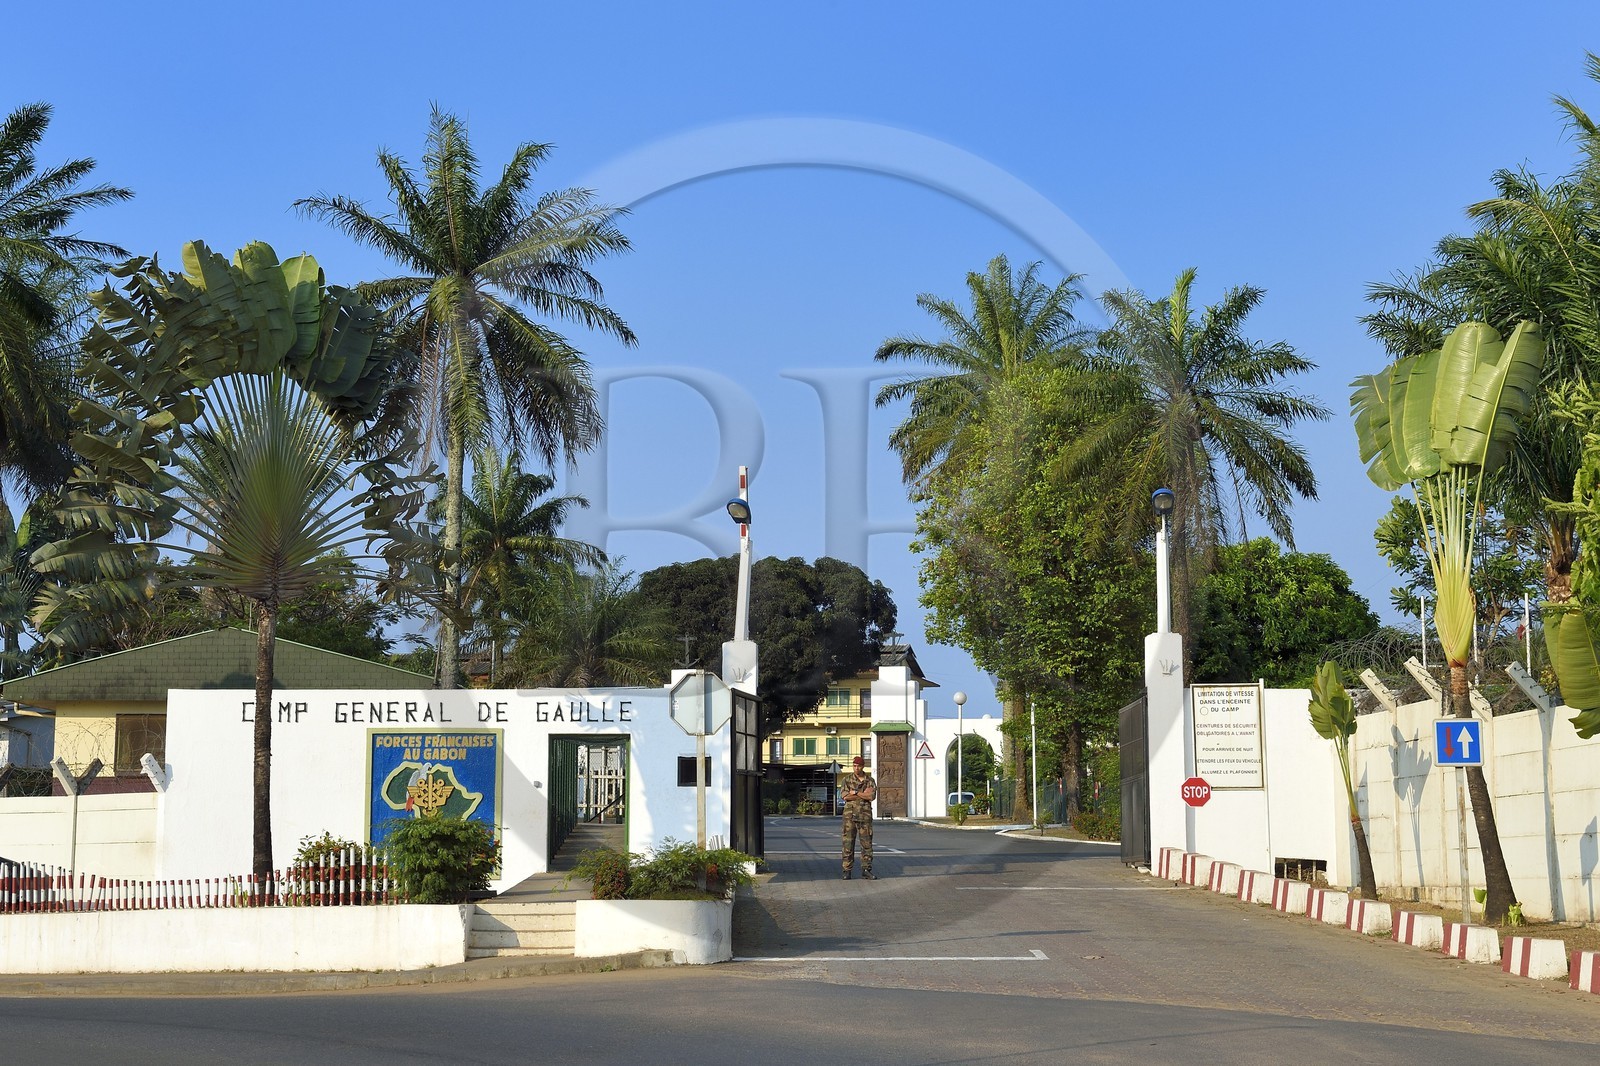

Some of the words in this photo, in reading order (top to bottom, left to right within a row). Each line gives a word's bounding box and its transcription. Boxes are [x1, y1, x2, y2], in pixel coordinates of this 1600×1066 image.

[241, 701, 308, 723] CMP
[335, 701, 453, 723] GENERAL
[478, 701, 508, 723] DE
[536, 701, 632, 723] GAULLE
[376, 736, 422, 747] FORCES
[403, 748, 420, 760] AU
[423, 748, 467, 760] GABON
[1183, 785, 1209, 799] STOP
